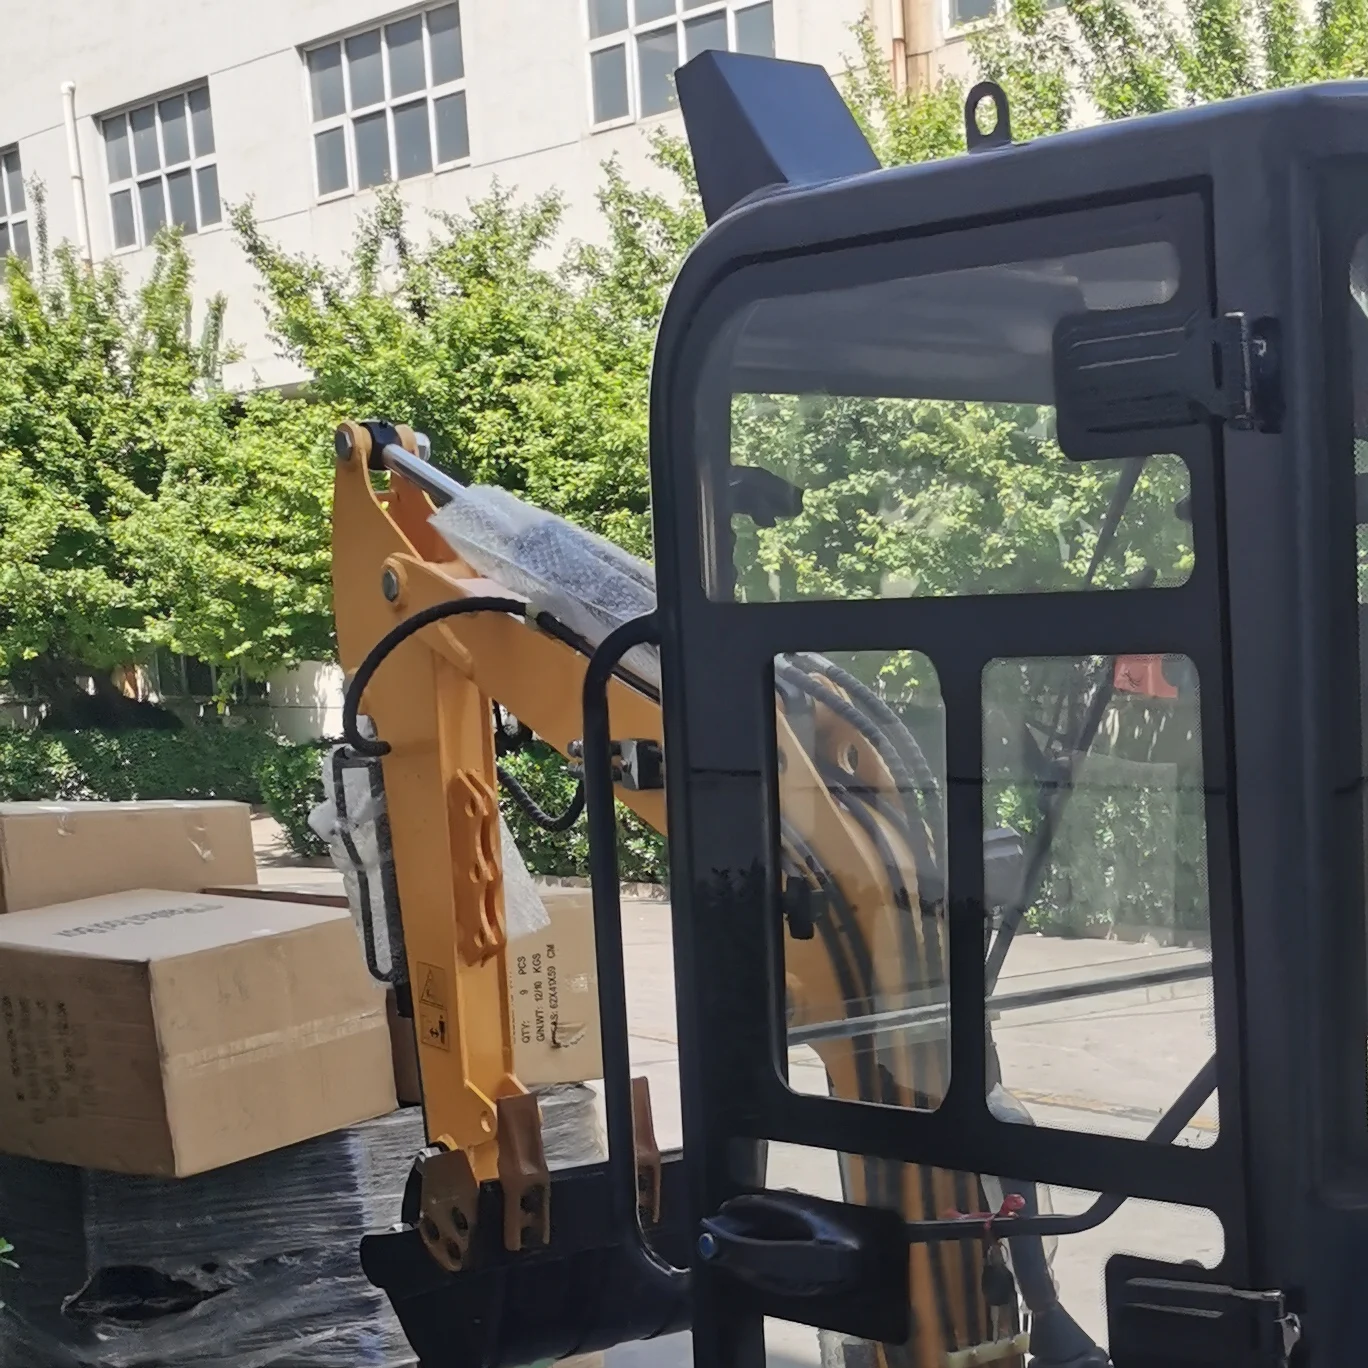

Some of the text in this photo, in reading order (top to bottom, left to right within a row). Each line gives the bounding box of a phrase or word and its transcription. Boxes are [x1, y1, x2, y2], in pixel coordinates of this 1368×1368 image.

[546, 943, 555, 959] CM
[517, 955, 527, 976] PCS
[532, 952, 541, 974] KGS
[533, 980, 544, 1002] 12/10
[521, 1020, 531, 1044] QTY:
